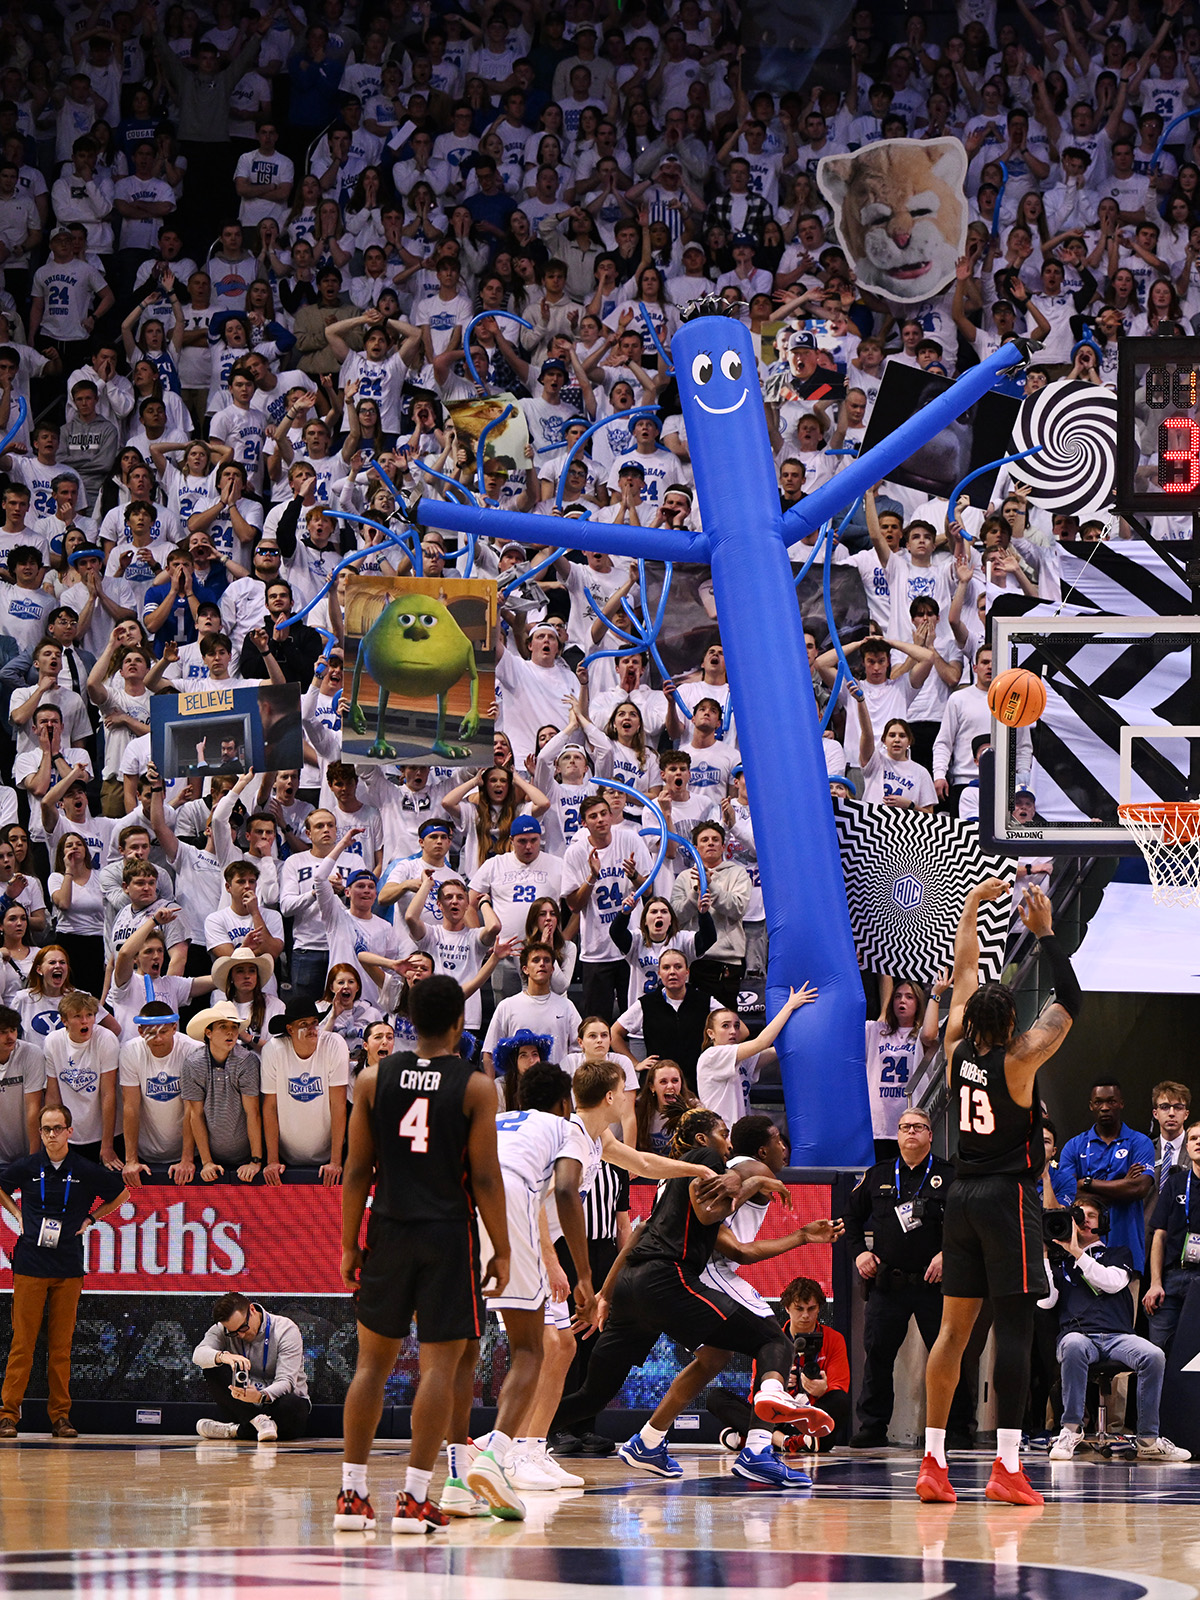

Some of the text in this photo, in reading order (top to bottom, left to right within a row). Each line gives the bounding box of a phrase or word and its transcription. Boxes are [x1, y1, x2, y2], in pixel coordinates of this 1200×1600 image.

[1154, 98, 1174, 114] 24
[255, 162, 277, 174] JUST
[257, 173, 272, 185] US
[44, 273, 78, 287] BRIGHAM
[48, 286, 70, 305] 24
[48, 306, 69, 316] YOUNG
[359, 377, 384, 397] 24
[242, 439, 261, 462] 24
[33, 491, 57, 513] 24
[210, 525, 235, 548] 24
[10, 602, 44, 617] BASKETBALL
[172, 606, 188, 643] 1
[188, 664, 210, 680] BY
[184, 689, 233, 712] BELIEVE
[1003, 691, 1021, 722] ELITE
[1005, 830, 1043, 840] SPALDING
[502, 870, 549, 884] BYU
[512, 884, 537, 903] 23
[595, 881, 624, 907] 24
[896, 877, 919, 906] ROC
[736, 1004, 766, 1013] BOARD
[880, 1056, 910, 1083] 24
[146, 1077, 182, 1095] BASKETBALL
[400, 1069, 442, 1091] CRYER
[958, 1084, 997, 1135] 13
[398, 1097, 430, 1154] 4
[83, 1202, 246, 1276] mith's
